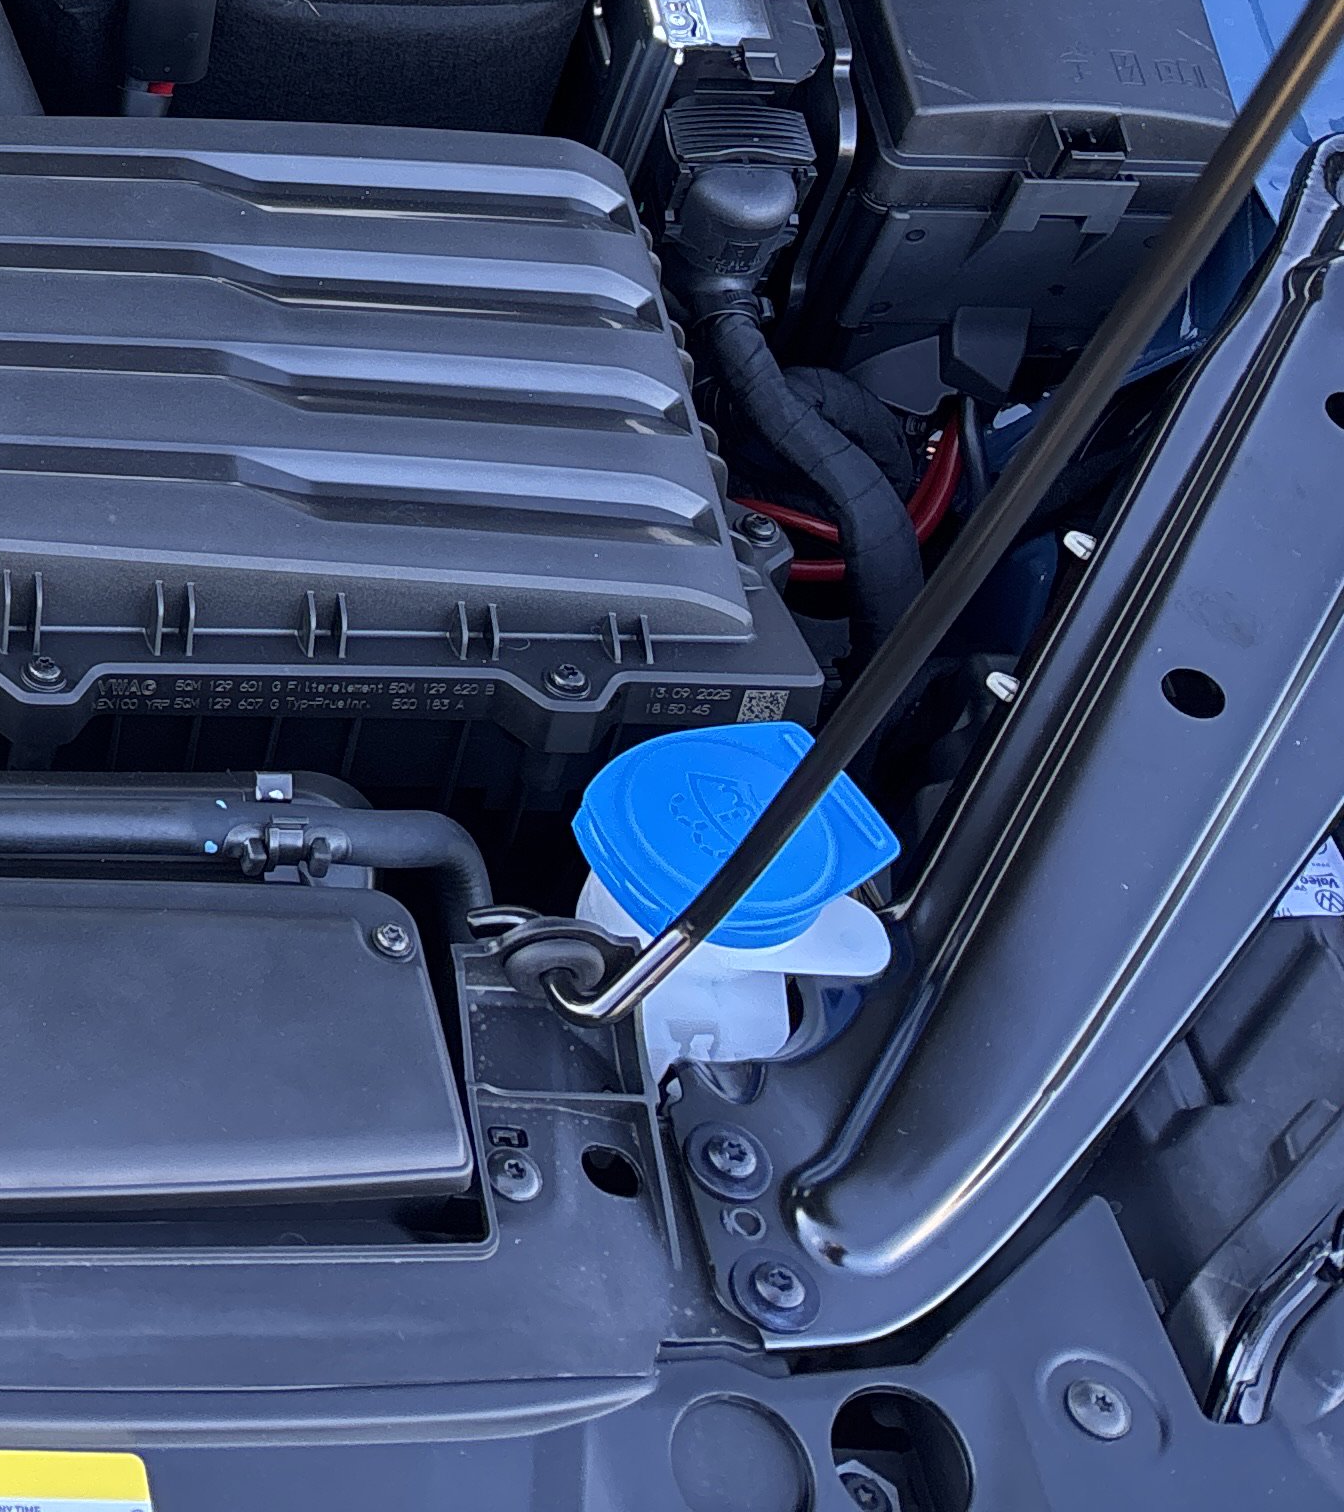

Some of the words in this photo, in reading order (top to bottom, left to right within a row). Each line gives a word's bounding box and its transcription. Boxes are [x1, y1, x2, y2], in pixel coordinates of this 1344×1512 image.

[209, 680, 233, 693] 129
[423, 683, 447, 695] 129
[649, 687, 732, 700] 13.09.2025
[207, 697, 232, 710] 129
[454, 699, 465, 710] A
[645, 702, 711, 716] 18:50:45
[1299, 875, 1340, 889] Valeo
